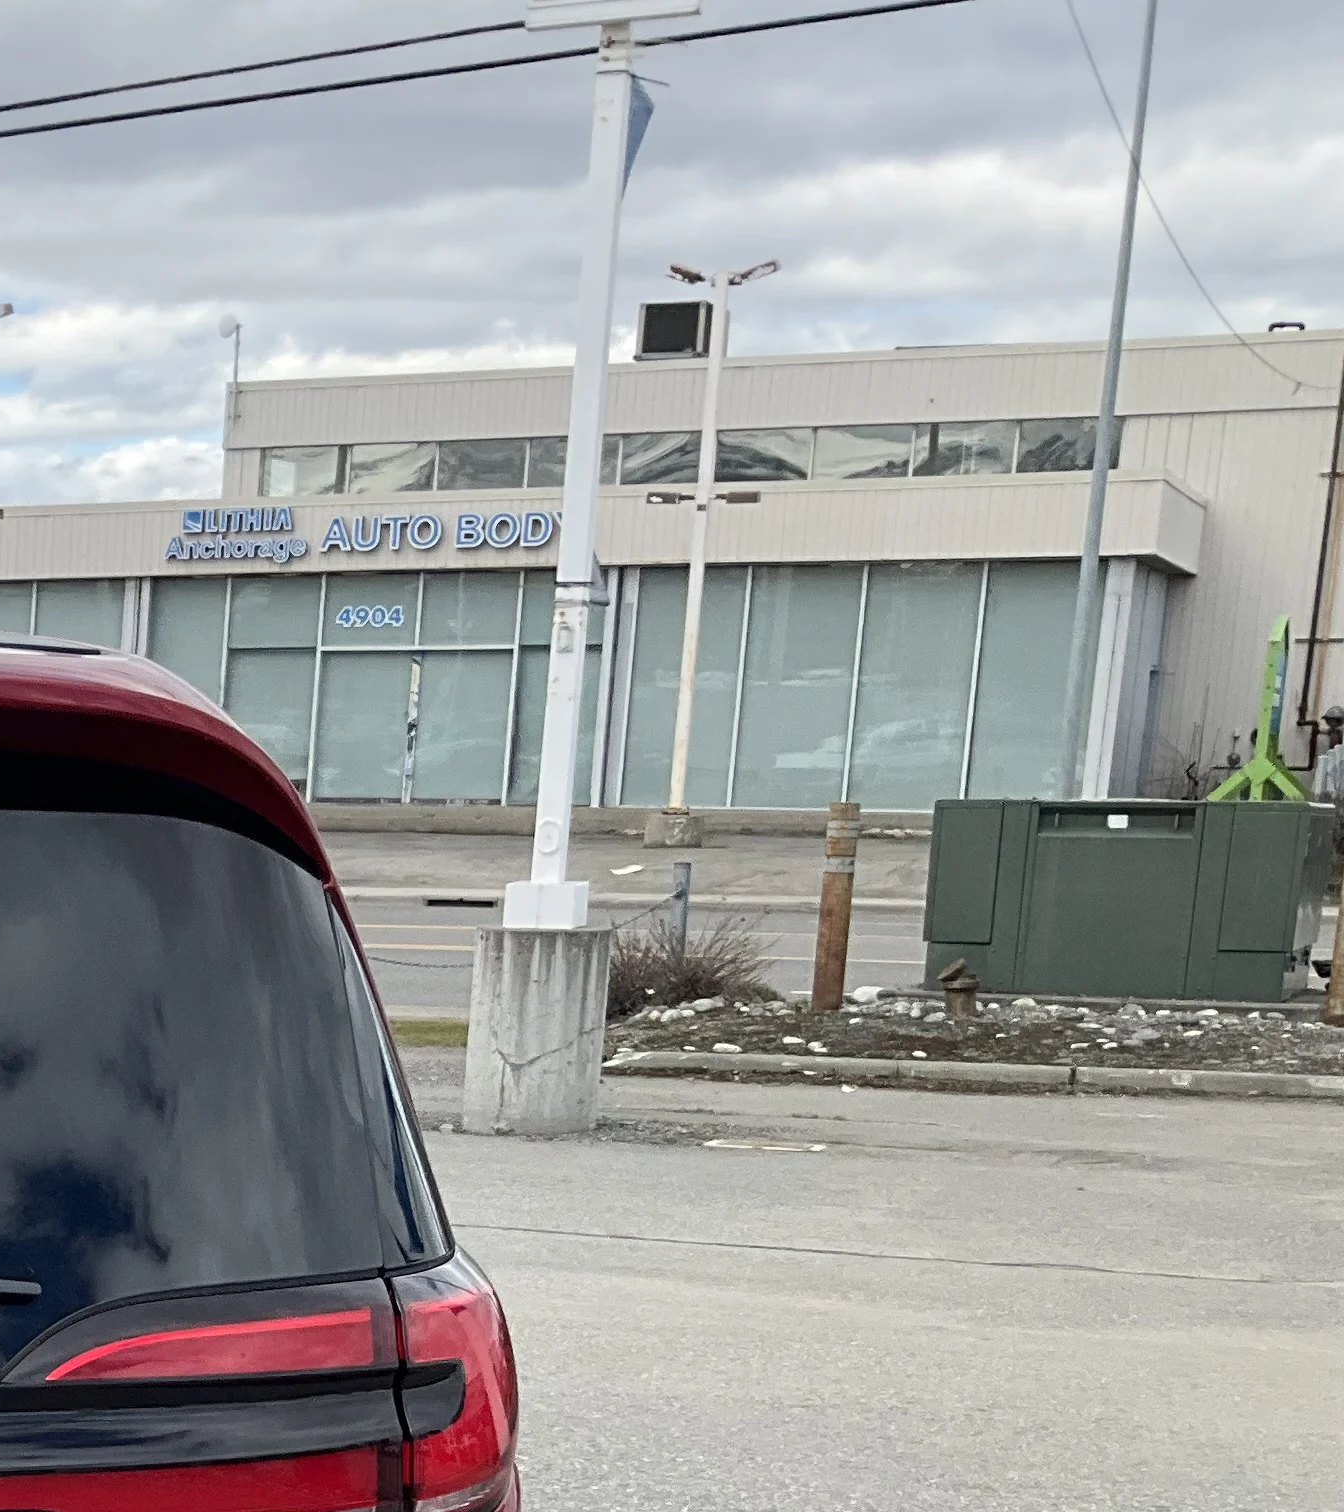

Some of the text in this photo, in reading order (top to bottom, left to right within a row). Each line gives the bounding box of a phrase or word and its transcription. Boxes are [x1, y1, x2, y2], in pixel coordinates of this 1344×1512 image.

[206, 506, 293, 533] LITHIA
[320, 511, 561, 552] AUTO BOD
[164, 535, 307, 564] Anchorage
[335, 605, 405, 629] 4904
